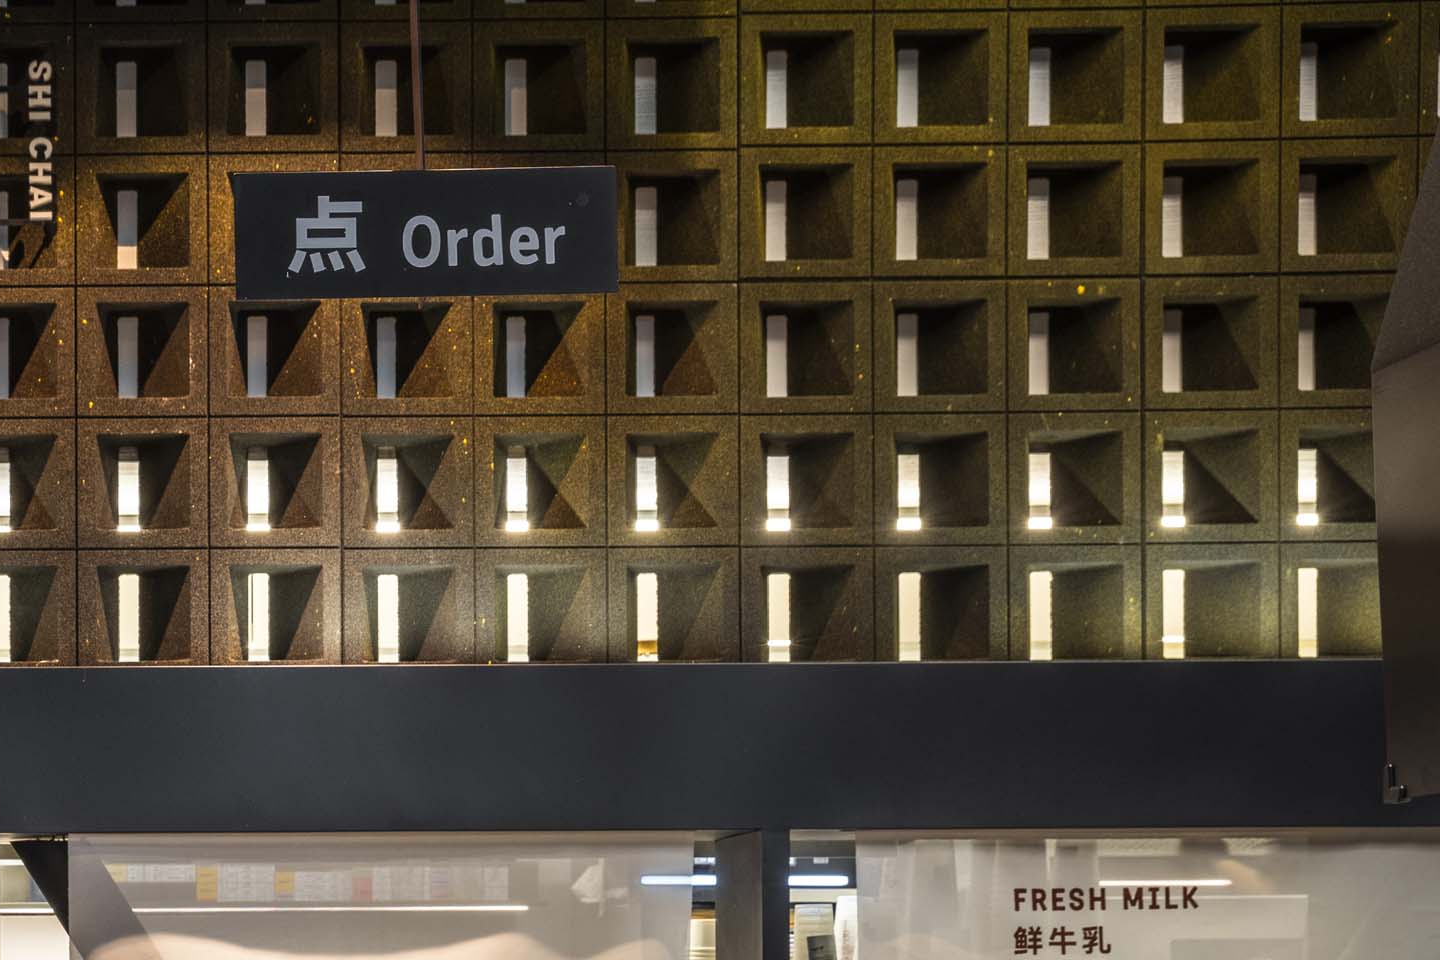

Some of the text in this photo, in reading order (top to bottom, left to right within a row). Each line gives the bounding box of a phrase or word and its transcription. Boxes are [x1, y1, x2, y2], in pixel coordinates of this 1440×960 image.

[28, 60, 53, 222] SHI CHAI
[287, 195, 566, 273] 点 Order
[1013, 886, 1200, 912] FRESH MILK
[1013, 925, 1112, 955] 鲜牛乳
